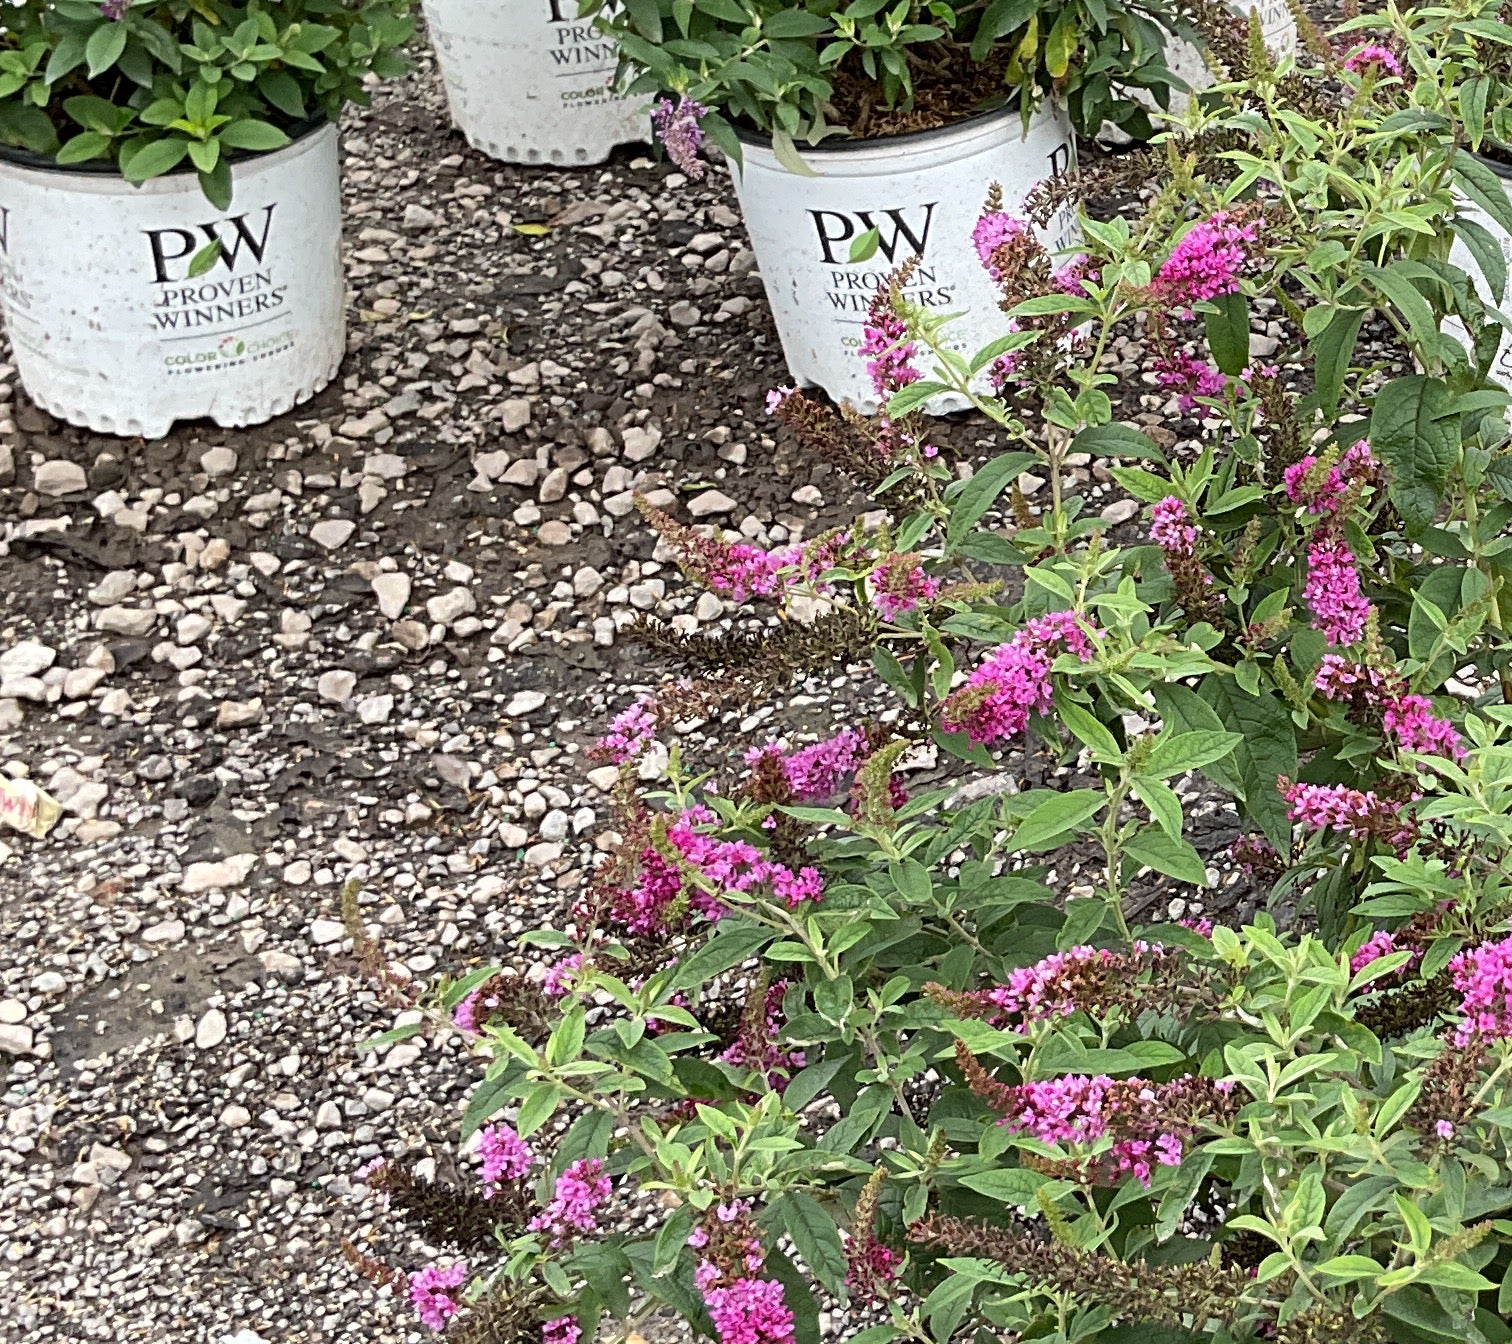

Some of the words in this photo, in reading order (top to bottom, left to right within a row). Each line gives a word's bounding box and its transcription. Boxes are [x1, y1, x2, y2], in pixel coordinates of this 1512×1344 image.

[548, 41, 620, 65] WINN
[556, 24, 603, 45] PRO
[140, 201, 278, 284] PW
[805, 201, 939, 264] PW
[161, 267, 272, 307] PROVEN
[826, 286, 952, 312] WINERS
[153, 285, 286, 331] WINNERS
[164, 351, 217, 367] COLOR
[247, 329, 300, 355] CHOICE
